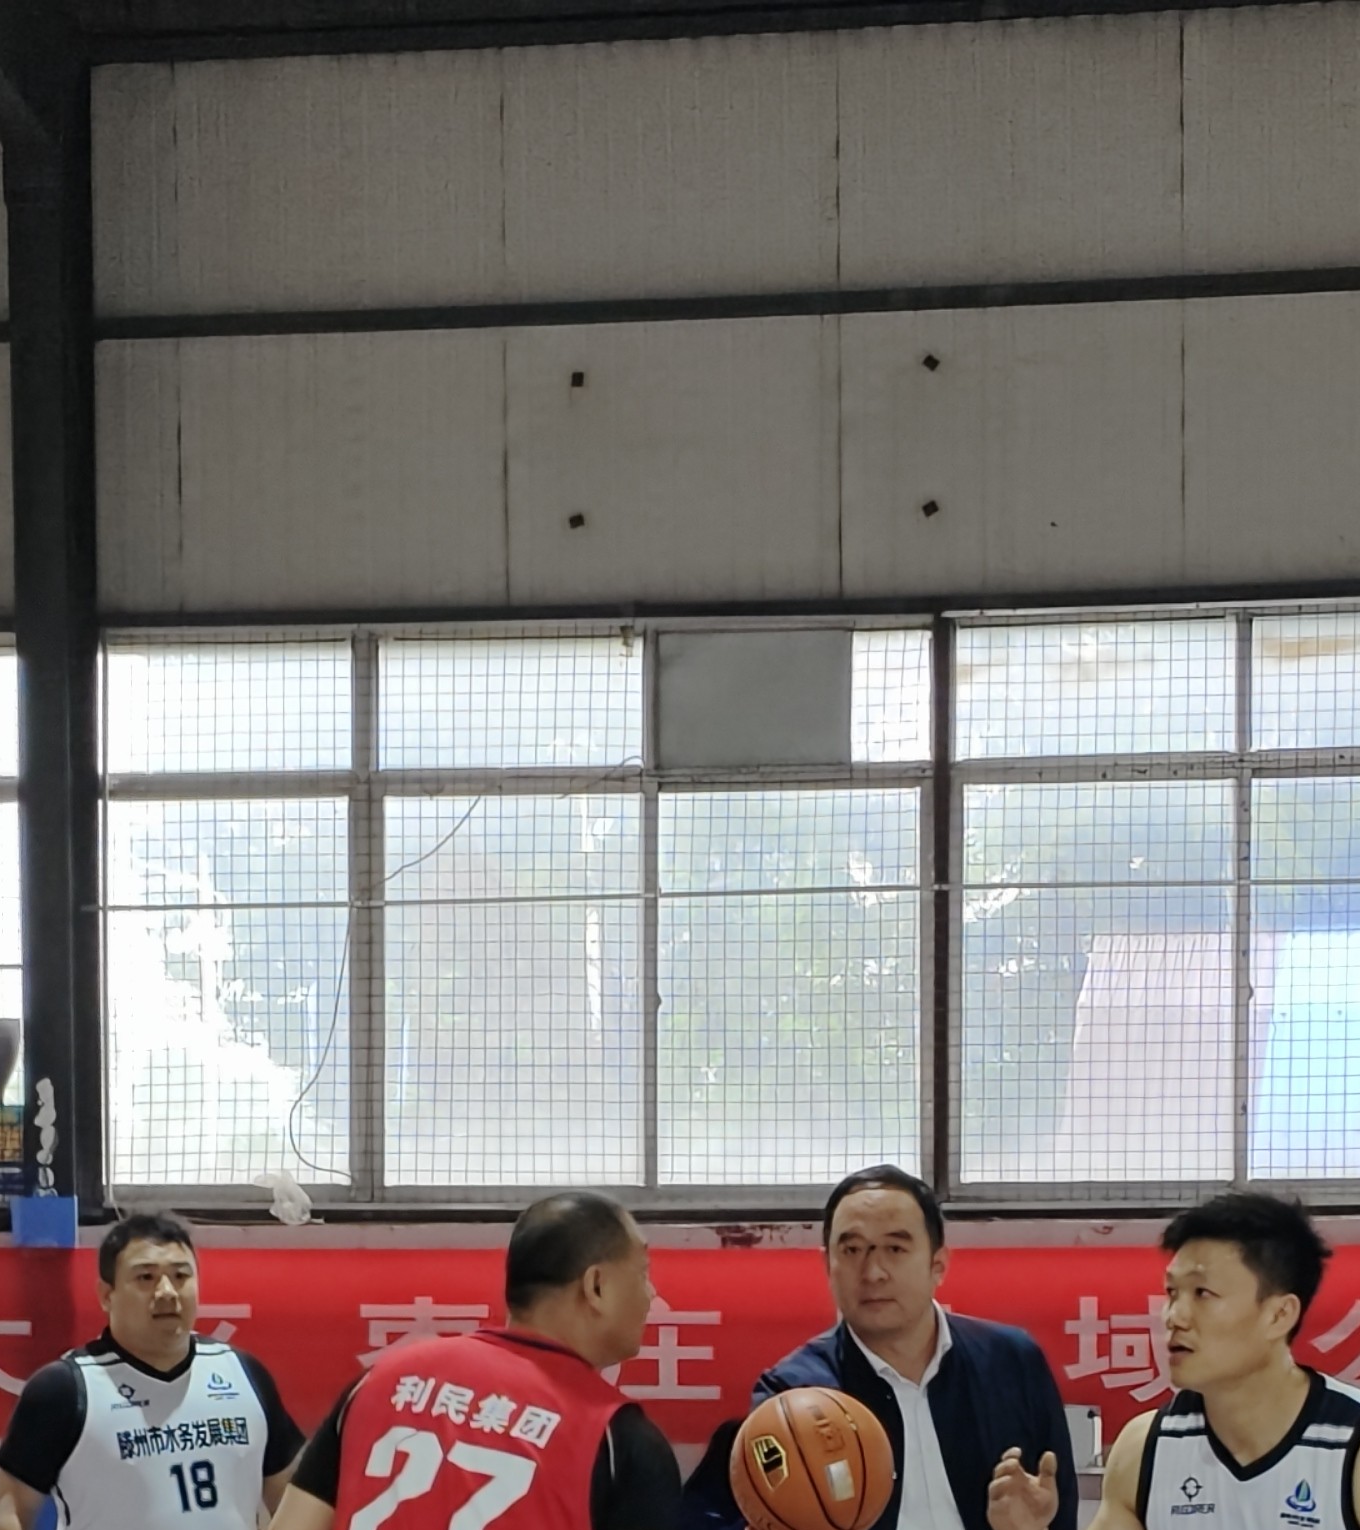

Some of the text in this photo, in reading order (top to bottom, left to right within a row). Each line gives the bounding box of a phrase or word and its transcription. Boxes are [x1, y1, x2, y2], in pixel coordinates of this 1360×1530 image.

[391, 1375, 561, 1449] 利民集团
[170, 1459, 218, 1512] 18
